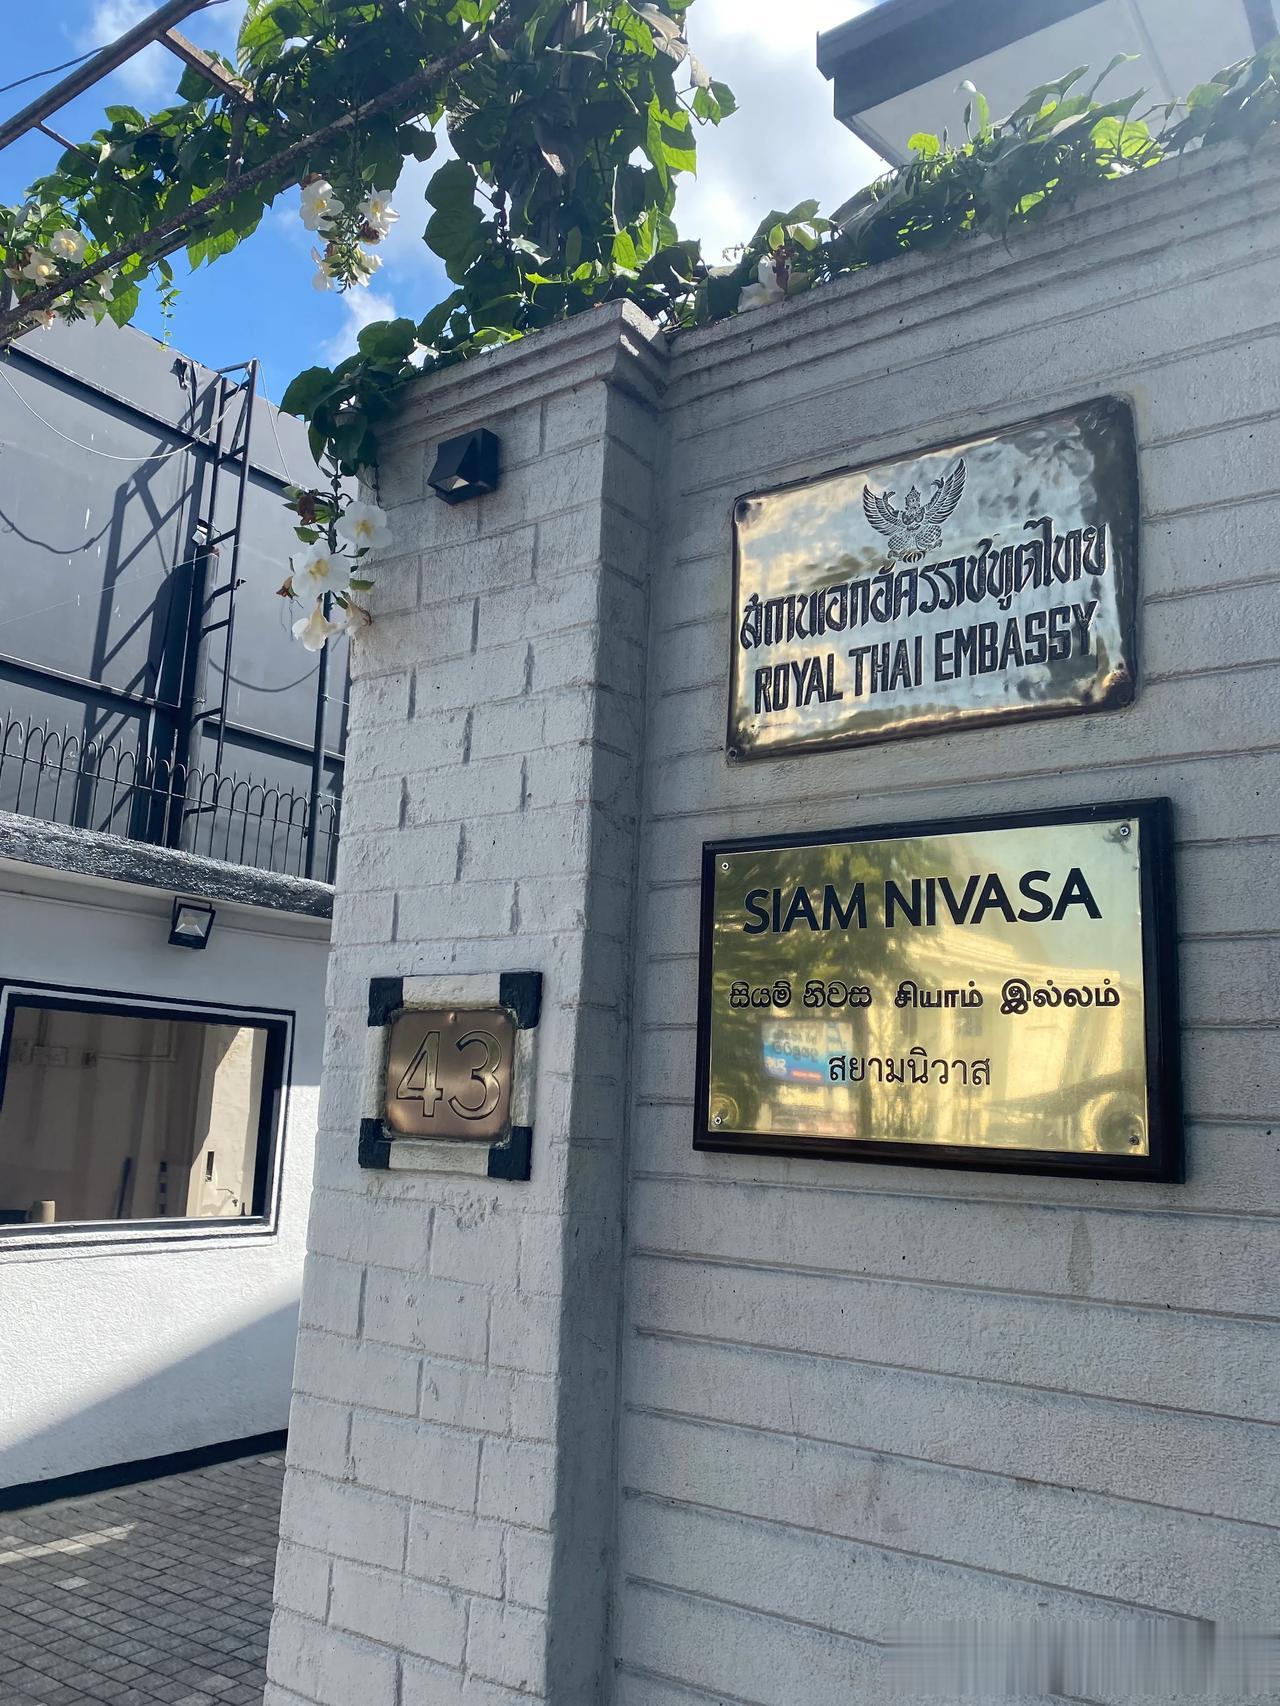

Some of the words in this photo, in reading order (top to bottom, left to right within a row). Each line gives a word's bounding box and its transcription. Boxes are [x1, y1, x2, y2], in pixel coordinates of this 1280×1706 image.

[739, 516, 1108, 650] สถานเอกอัครราชทูตไทย
[753, 653, 844, 715] ROYAL
[849, 636, 923, 697] THAI
[934, 600, 1098, 682] EMBASSY
[743, 882, 868, 935] SIAM
[885, 867, 1103, 929] NIVASA
[729, 979, 792, 1009] සියම්
[894, 979, 984, 1009] சியாம்
[1000, 977, 1121, 1015] இல்லம்
[396, 1030, 503, 1121] 43
[828, 1046, 991, 1086] สยามนิวาส
